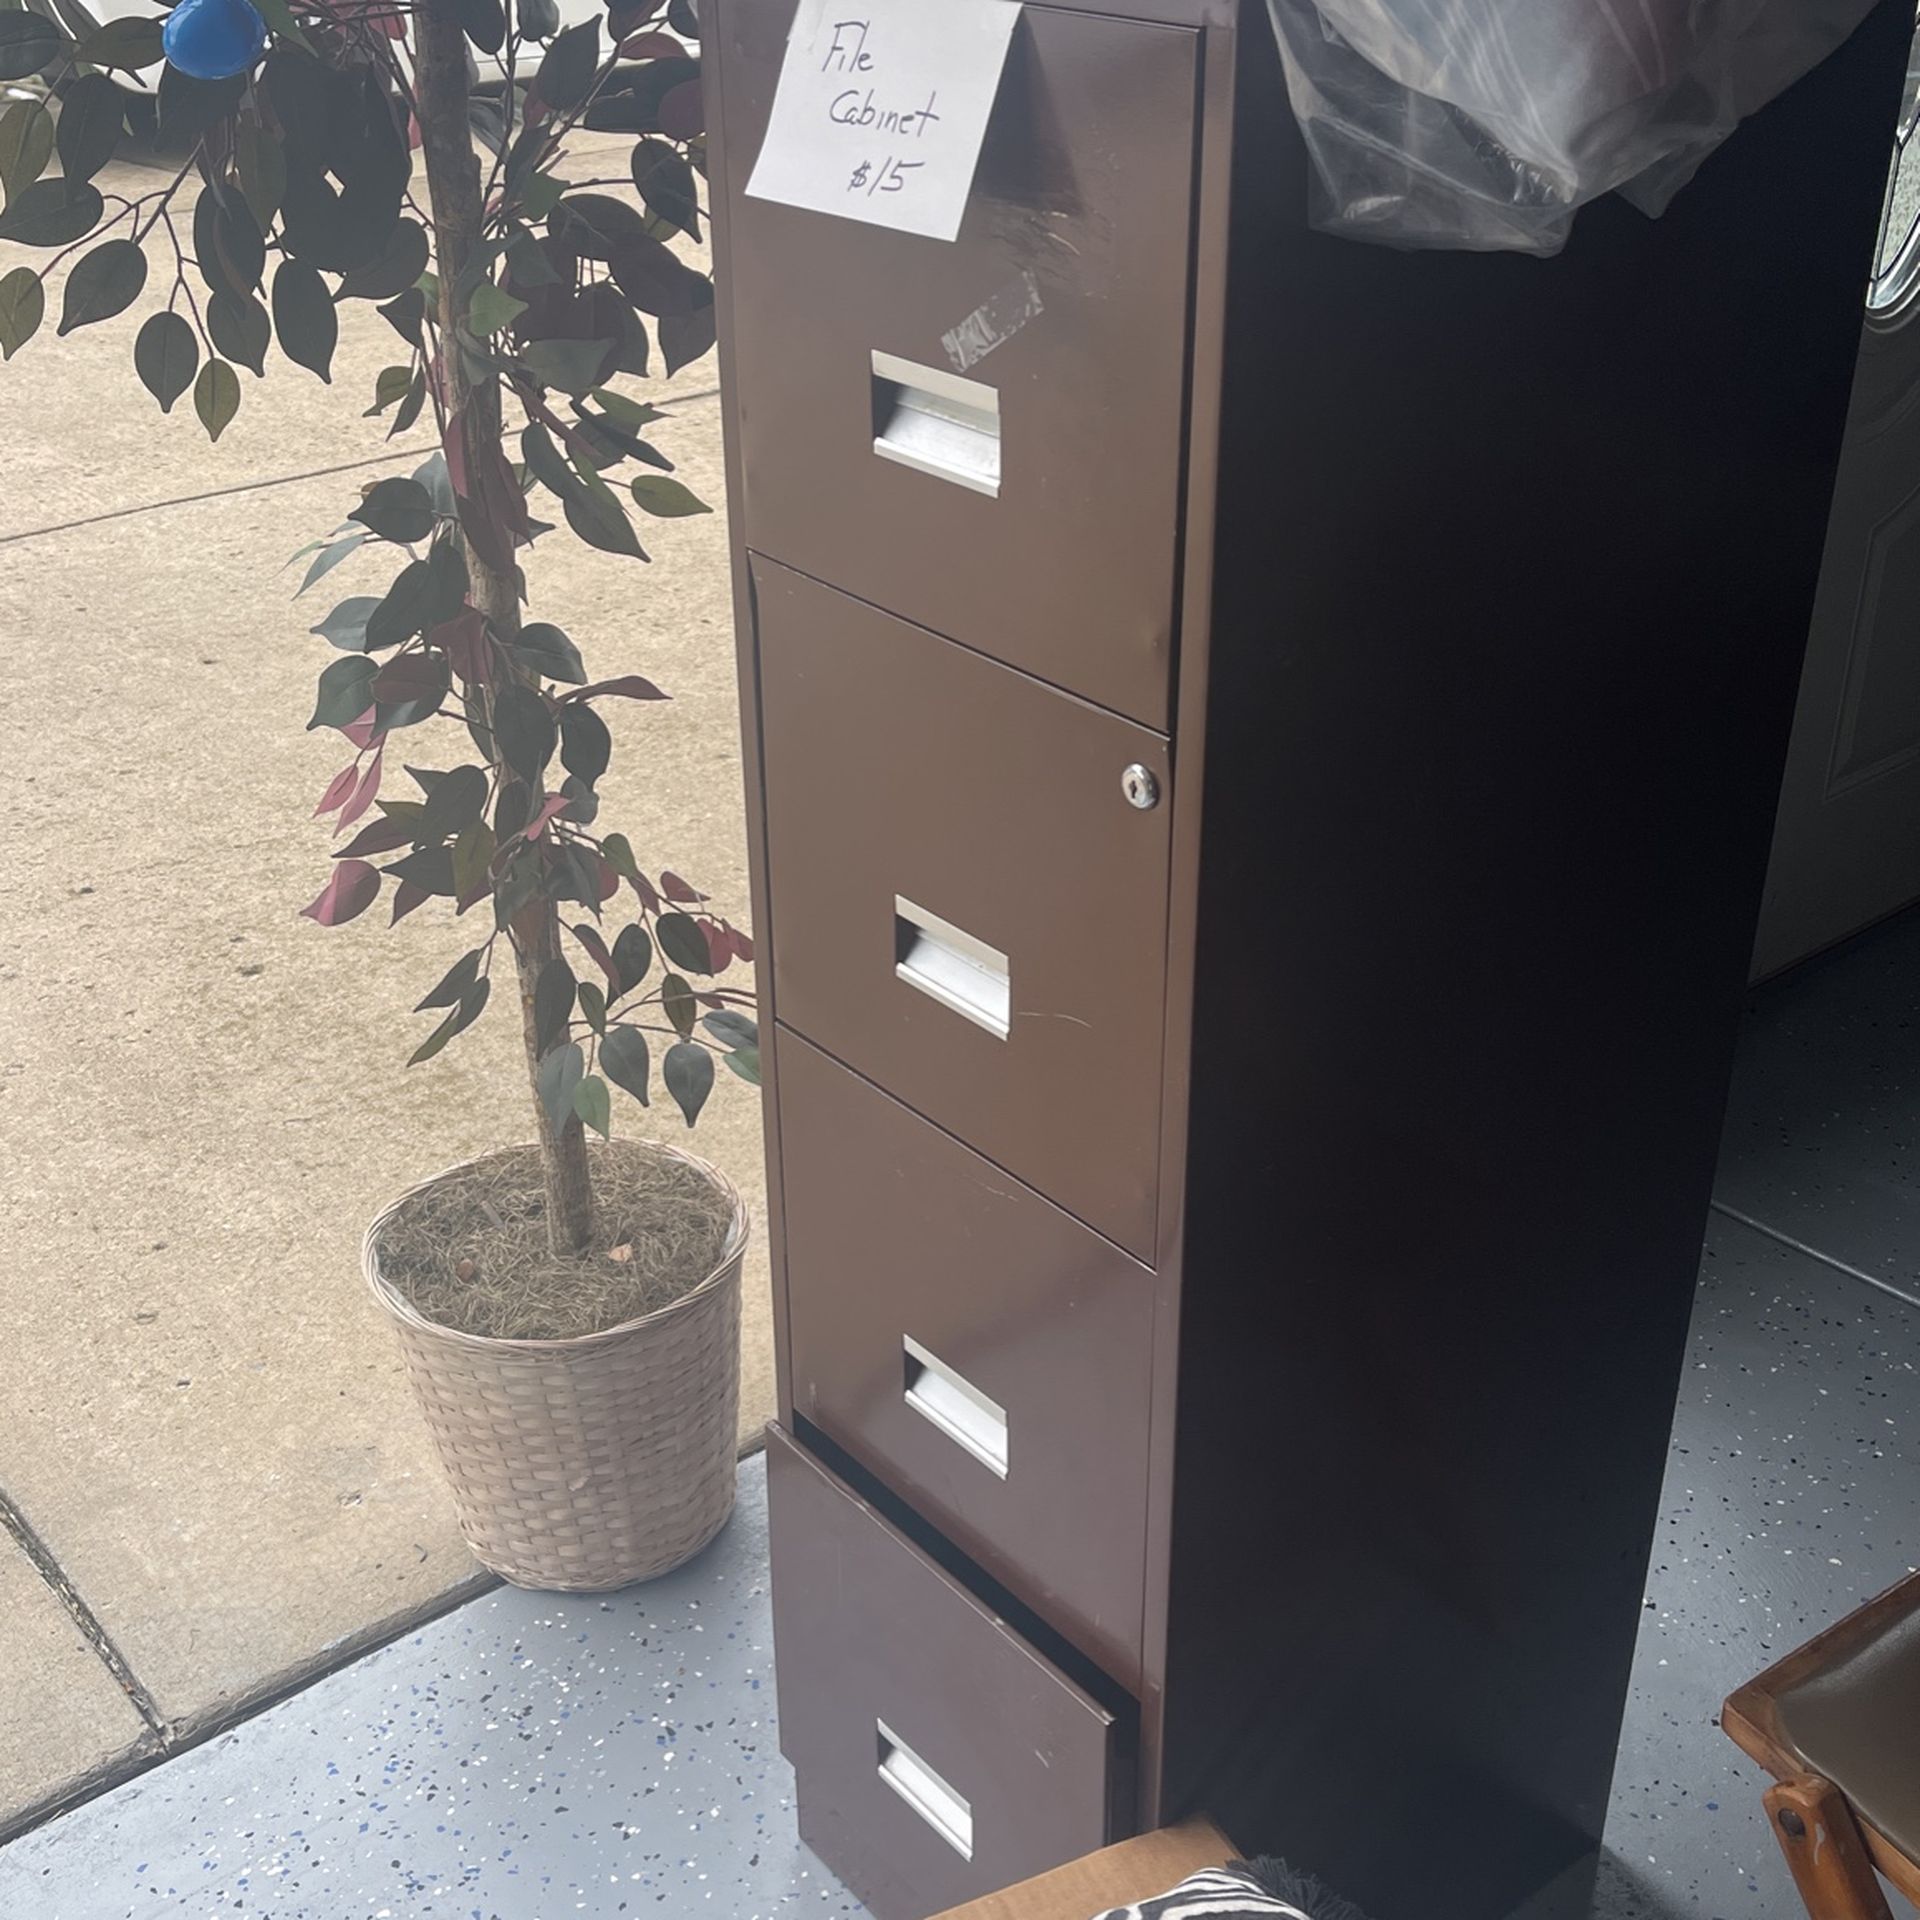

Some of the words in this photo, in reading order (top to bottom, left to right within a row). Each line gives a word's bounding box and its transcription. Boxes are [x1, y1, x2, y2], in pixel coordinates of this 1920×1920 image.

[821, 20, 874, 72] File
[829, 88, 940, 137] Cabinet
[847, 156, 925, 196] $15
